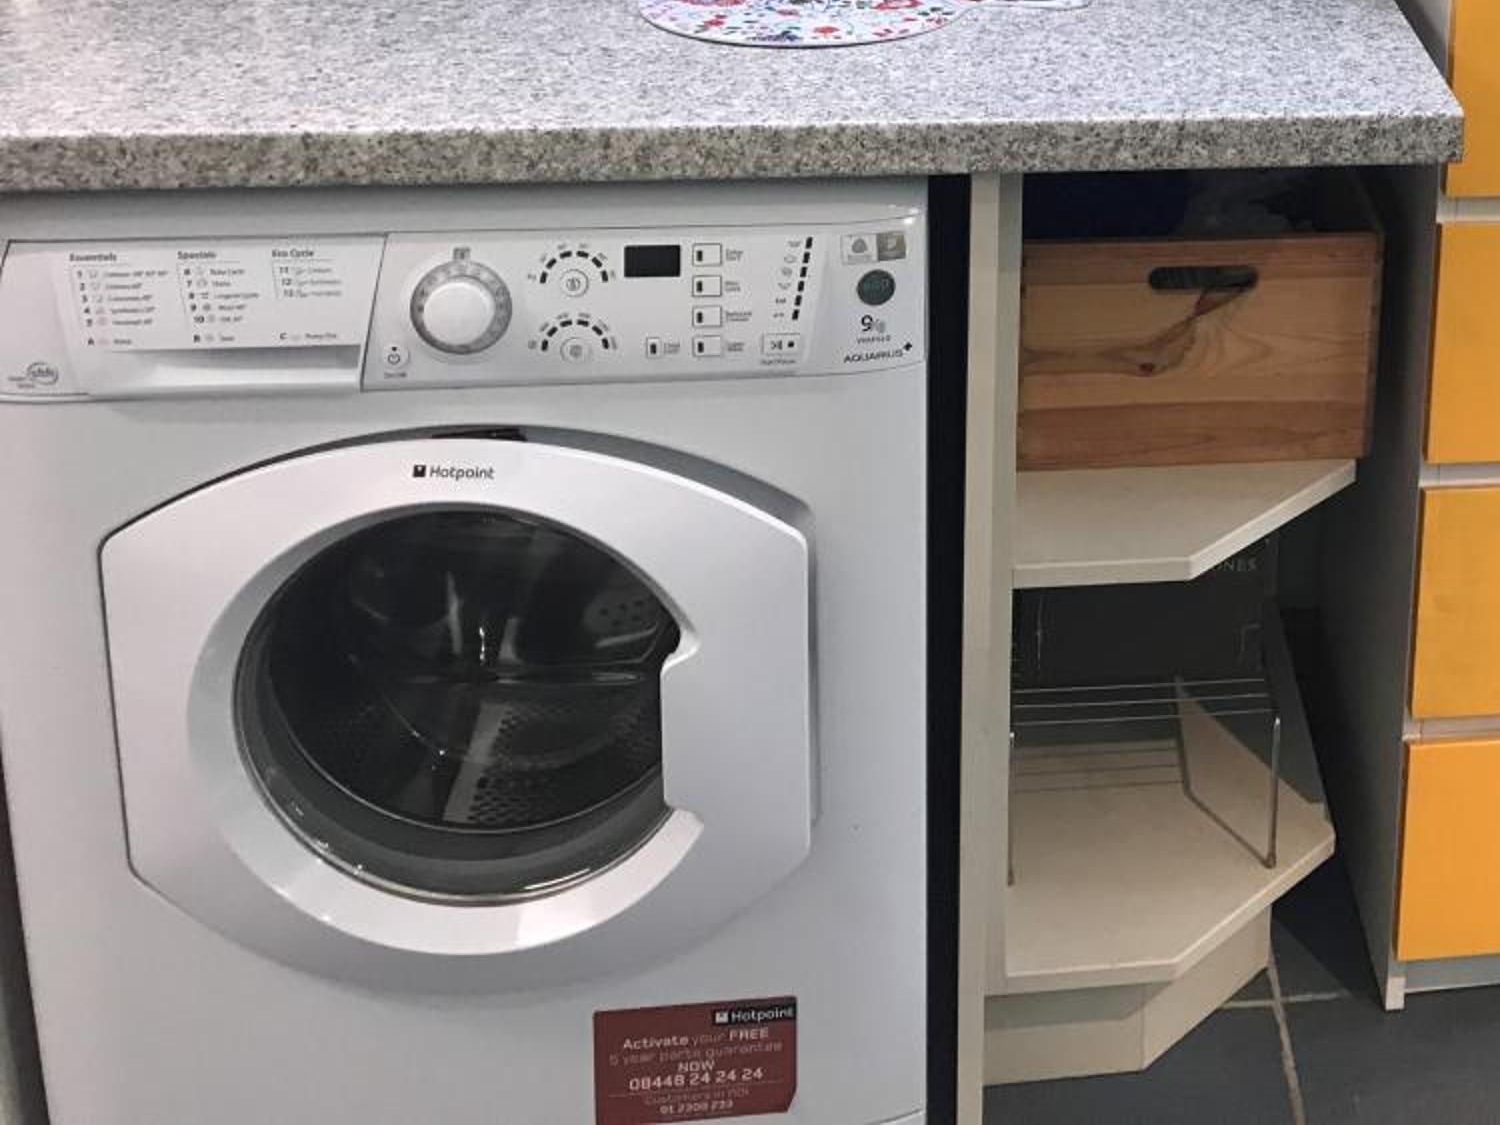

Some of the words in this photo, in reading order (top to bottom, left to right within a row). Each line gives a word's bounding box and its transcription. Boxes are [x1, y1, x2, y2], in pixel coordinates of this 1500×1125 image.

[861, 315, 873, 332] 9
[429, 466, 494, 481] Hotpoint
[730, 1007, 794, 1022] Hotpoint
[623, 1035, 689, 1050] Activate
[692, 1033, 725, 1046] your
[729, 1027, 769, 1041] FREE
[705, 1041, 783, 1058] guarantee
[677, 1060, 715, 1073] NOW
[628, 1075, 685, 1090] 08448
[689, 1072, 711, 1086] 24
[715, 1070, 737, 1083] 24
[741, 1067, 764, 1081] 24
